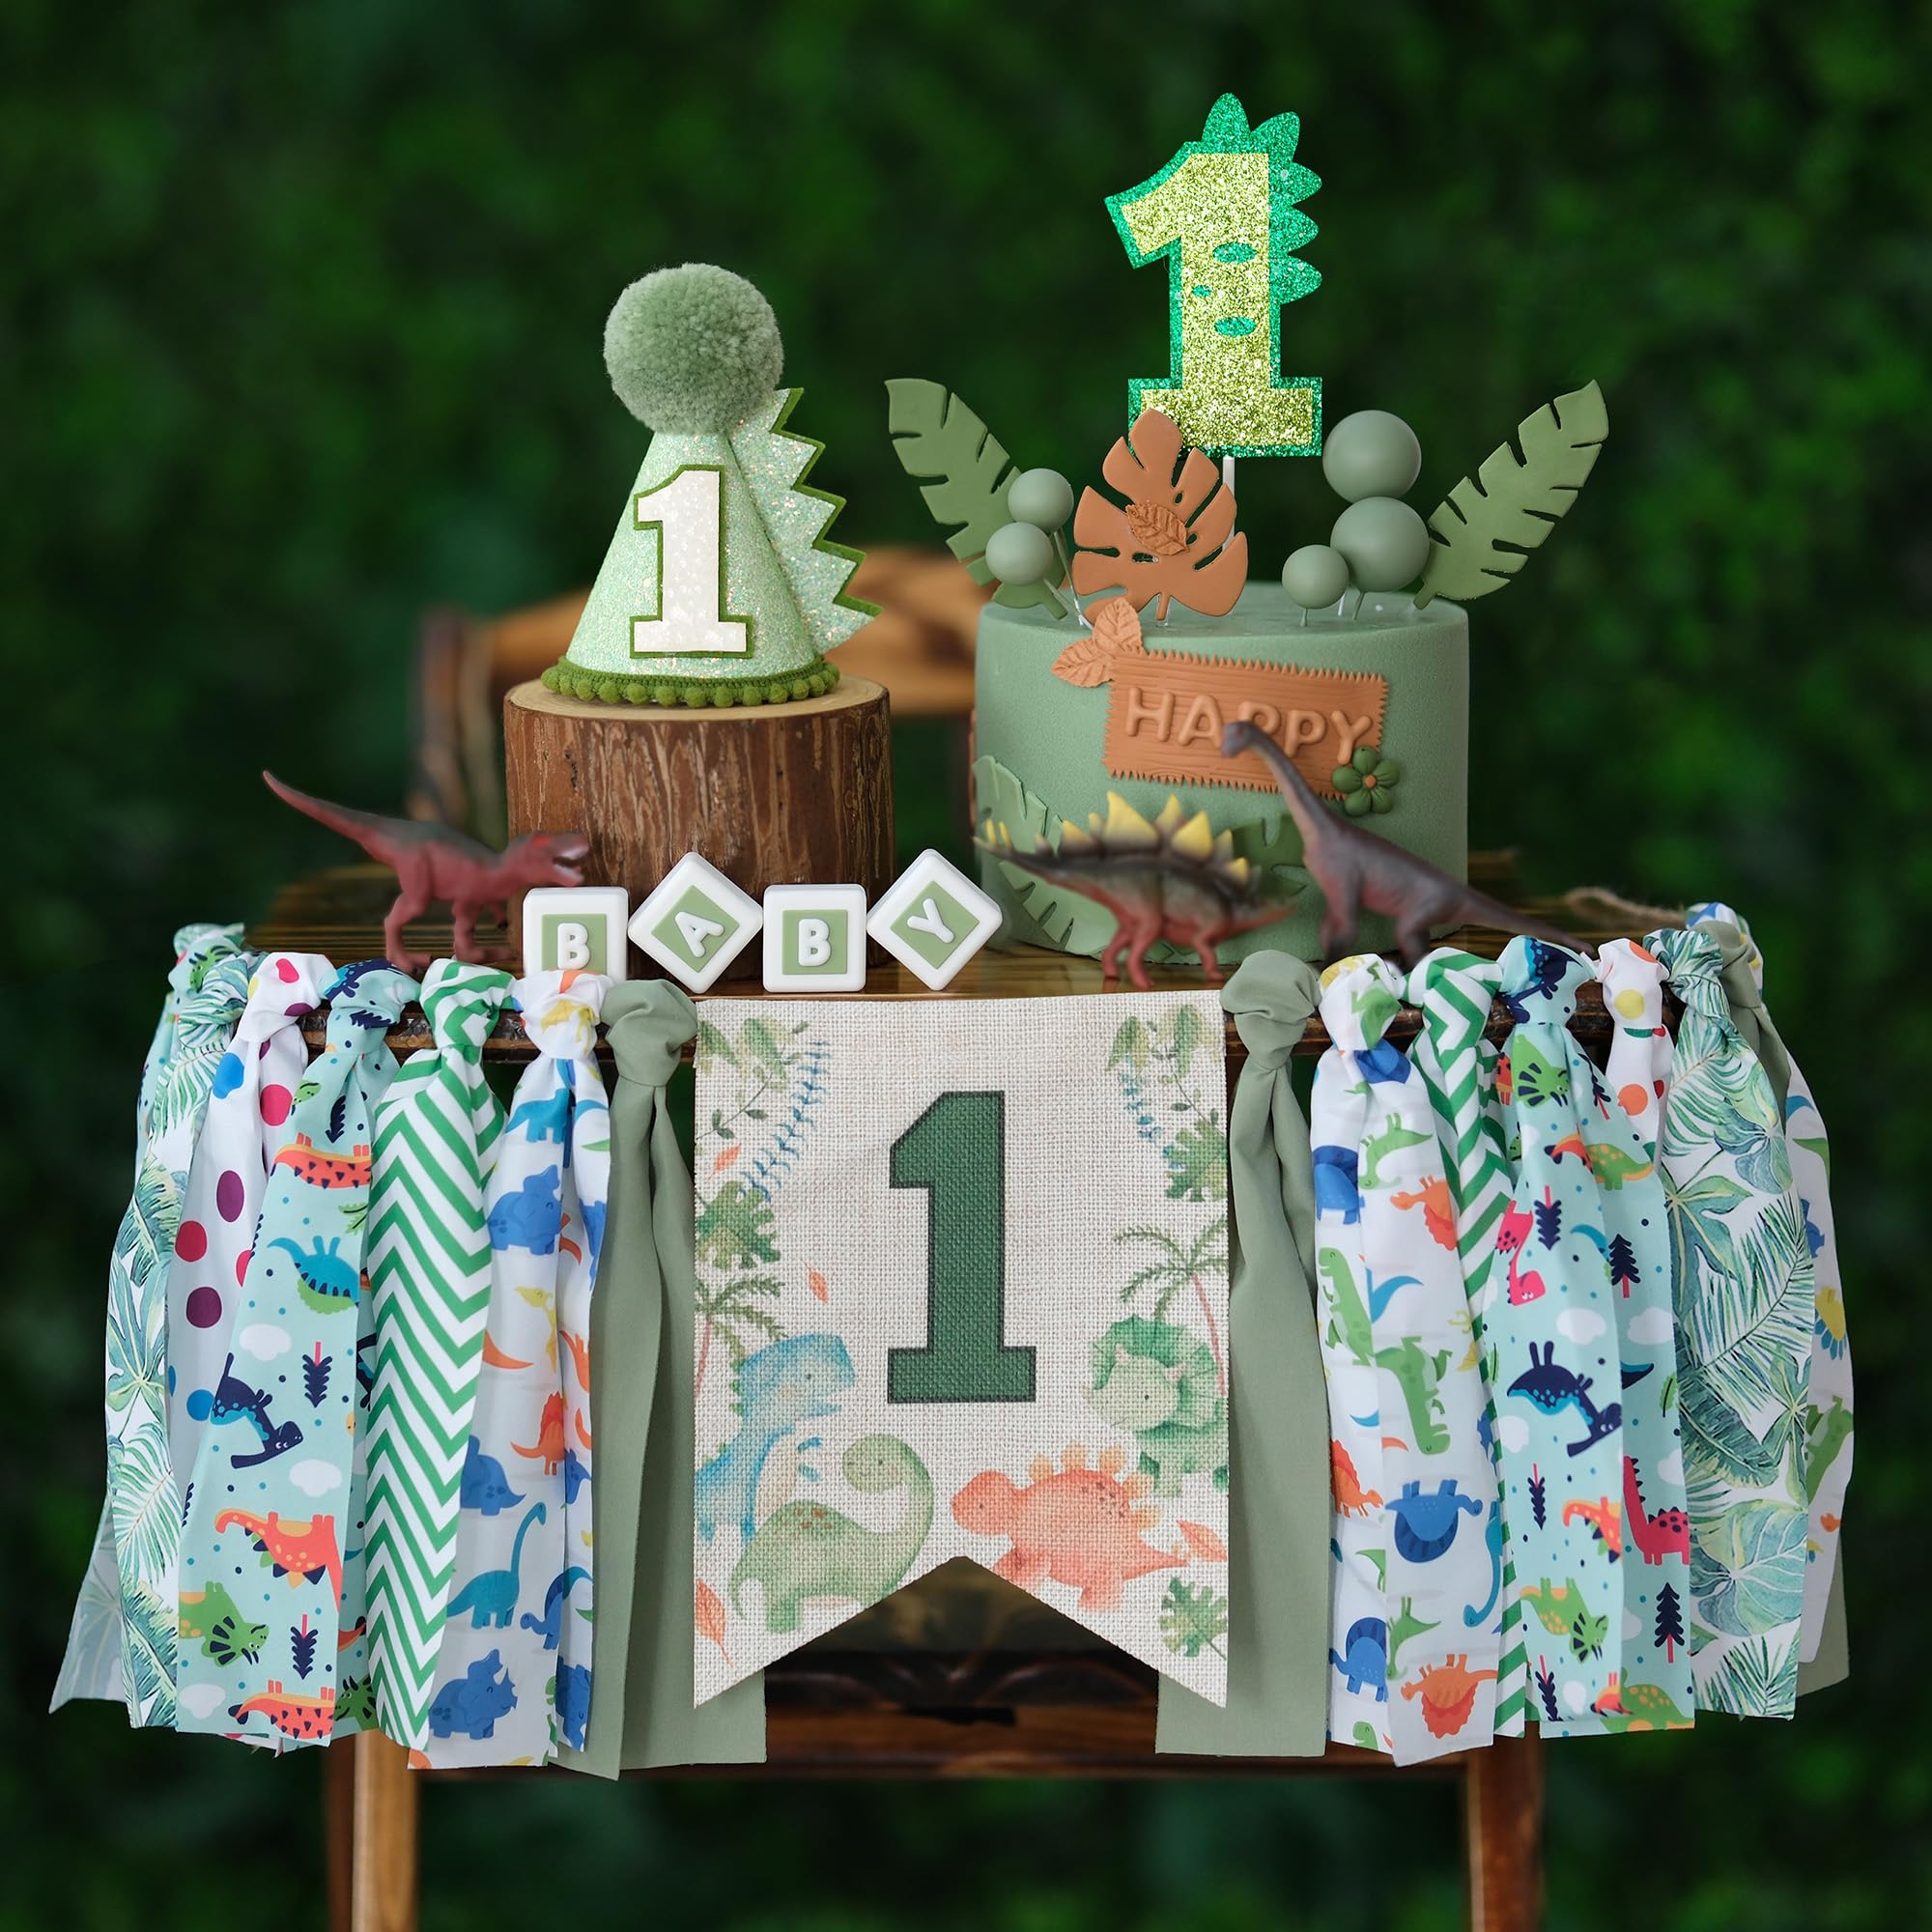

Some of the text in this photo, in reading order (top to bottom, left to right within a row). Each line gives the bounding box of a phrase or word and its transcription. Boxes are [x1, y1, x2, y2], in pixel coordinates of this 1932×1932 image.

[1104, 141, 1322, 456] 1
[630, 465, 753, 659] 1
[556, 898, 954, 969] BABY
[887, 1091, 1037, 1404] 1
